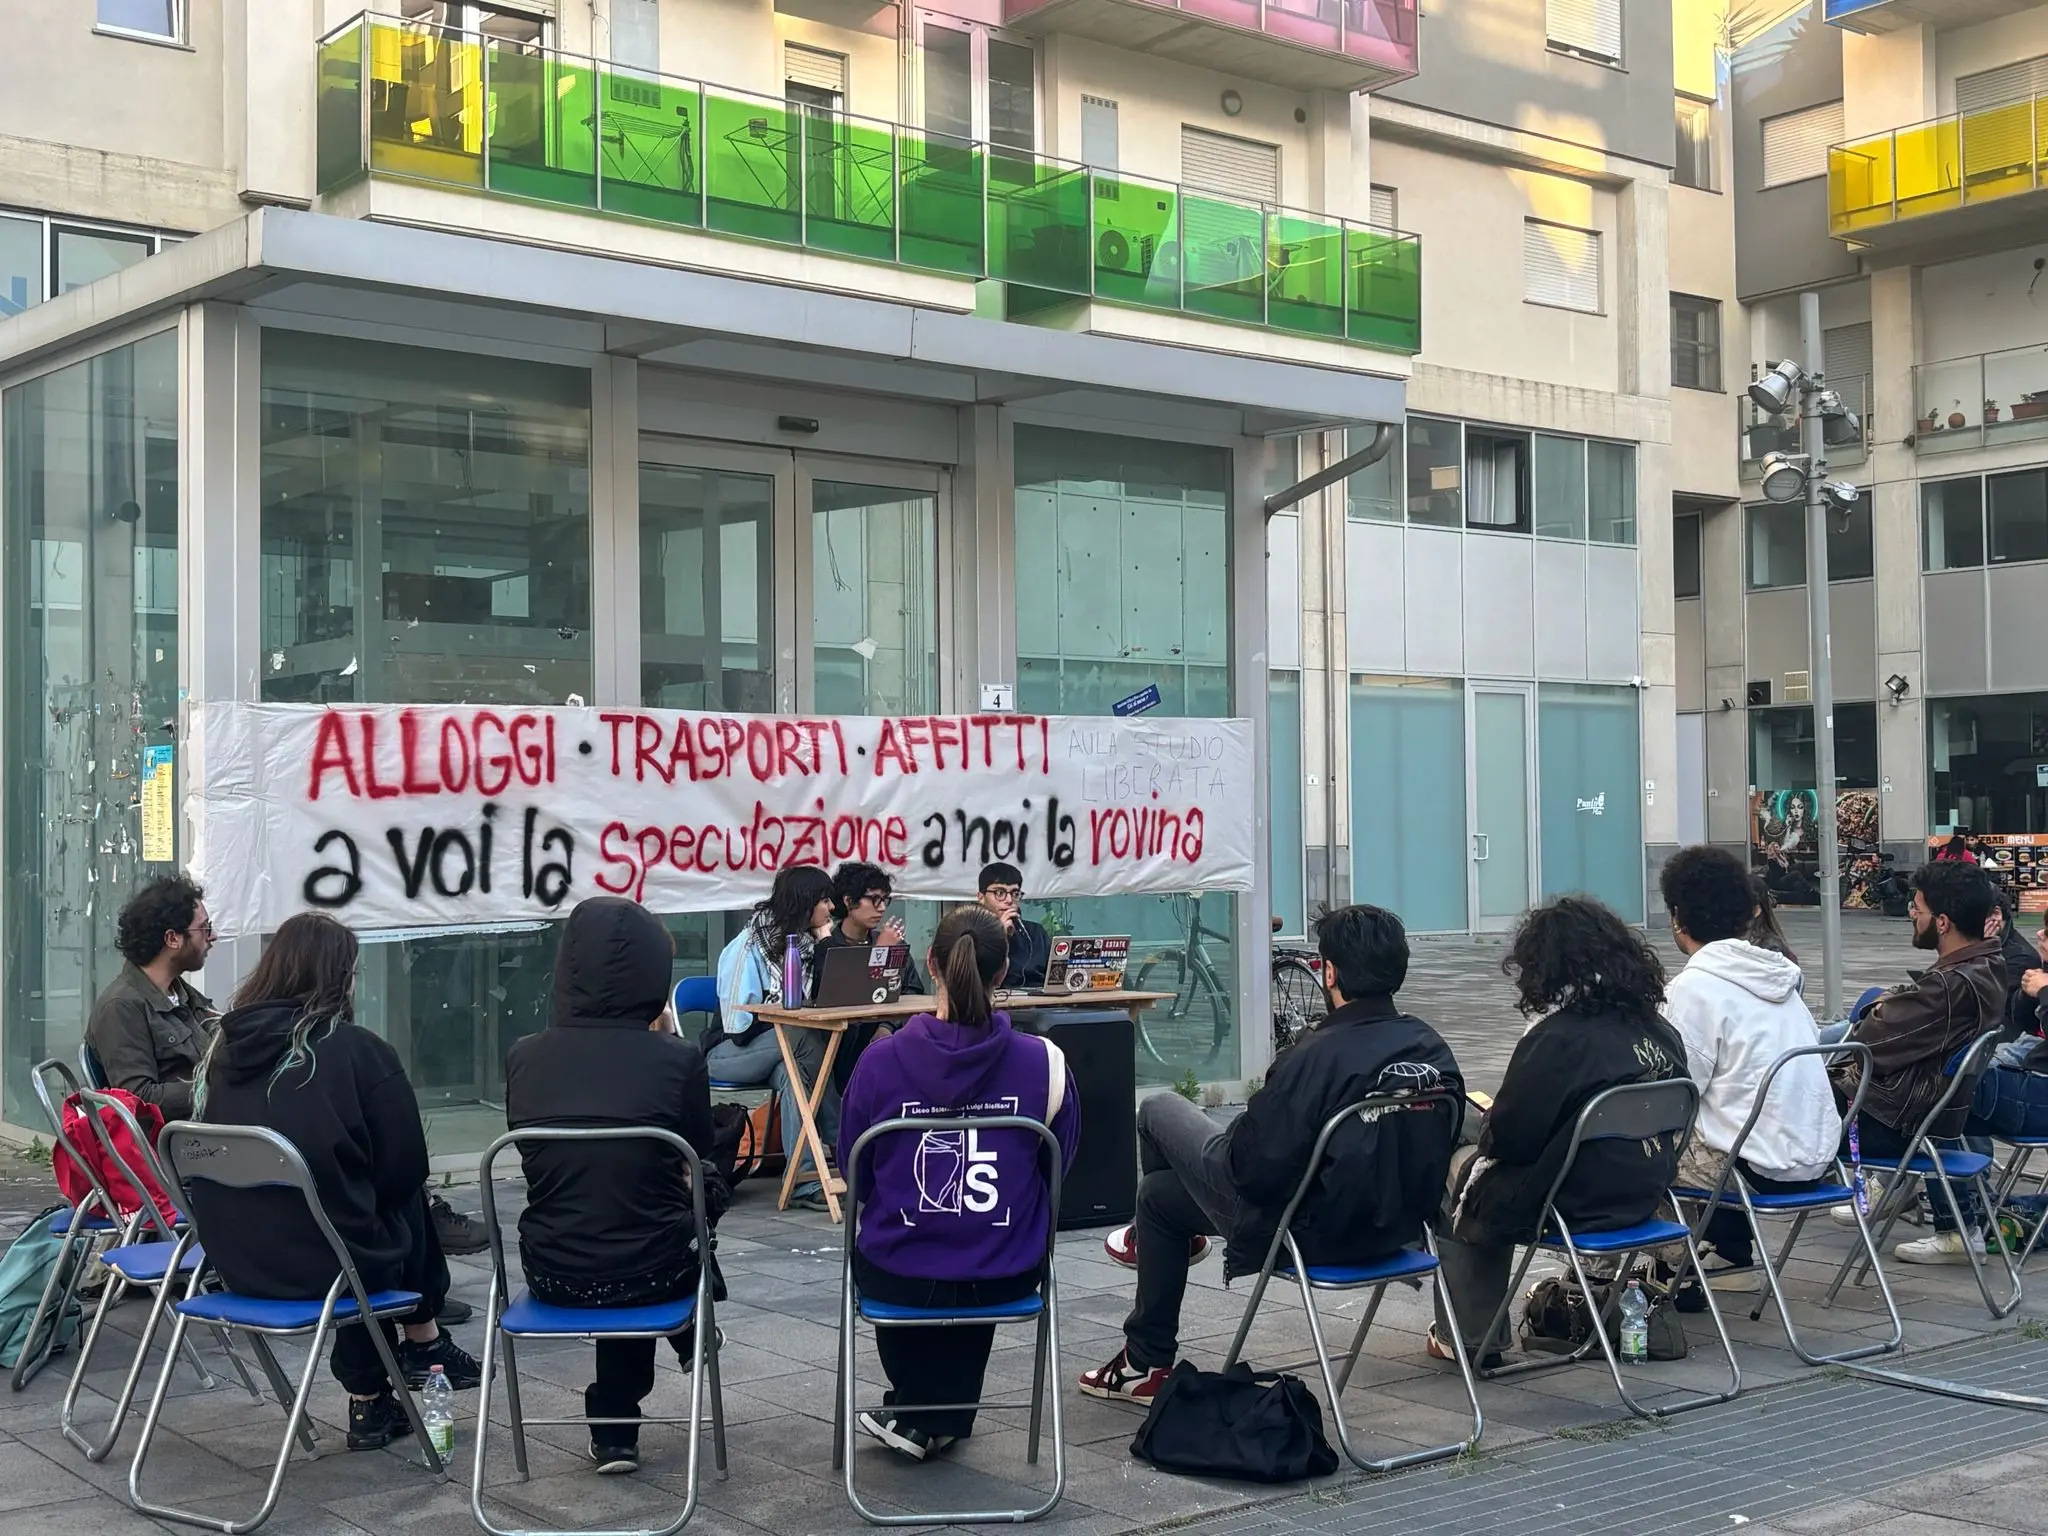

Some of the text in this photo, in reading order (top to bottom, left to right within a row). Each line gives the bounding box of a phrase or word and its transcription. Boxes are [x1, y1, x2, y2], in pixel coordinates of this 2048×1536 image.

[992, 693, 1001, 708] 4
[308, 708, 1049, 800] ALLOGGI TRASPORTI AFFITTI
[1069, 729, 1224, 760] AULA STUDIO
[1082, 763, 1226, 802] LIBERATA
[304, 829, 363, 908] a
[386, 803, 498, 899] voi
[523, 807, 574, 908] la
[595, 797, 907, 904] speculazione
[1046, 798, 1076, 868] la
[1090, 790, 1204, 864] rovina
[2008, 835, 2034, 844] MENU
[968, 1116, 998, 1162] L
[963, 1163, 999, 1213] S
